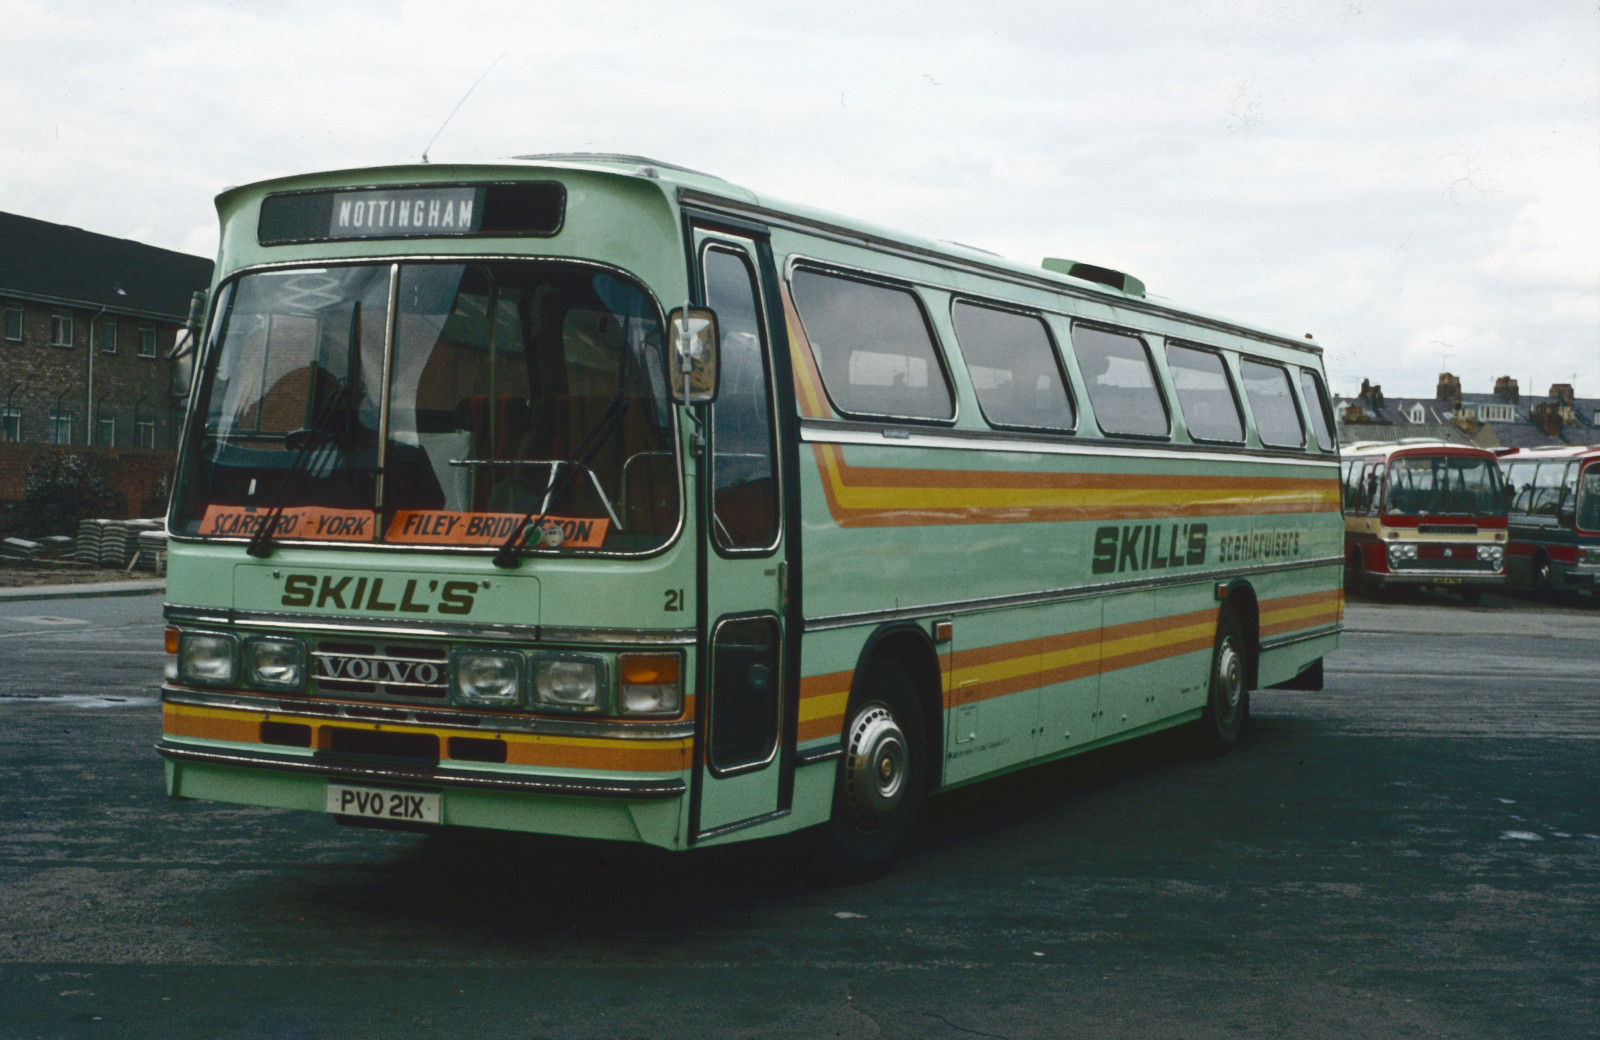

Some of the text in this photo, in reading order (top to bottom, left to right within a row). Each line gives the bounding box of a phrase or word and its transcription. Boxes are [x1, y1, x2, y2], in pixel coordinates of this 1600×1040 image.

[338, 199, 474, 228] NOTTINGHAM
[316, 514, 372, 536] YORK
[1092, 523, 1208, 575] SKILL'S
[281, 574, 479, 615] SKILL'S
[664, 588, 684, 611] 21
[317, 656, 440, 684] VOLVO
[341, 789, 424, 819] PVO 21X
